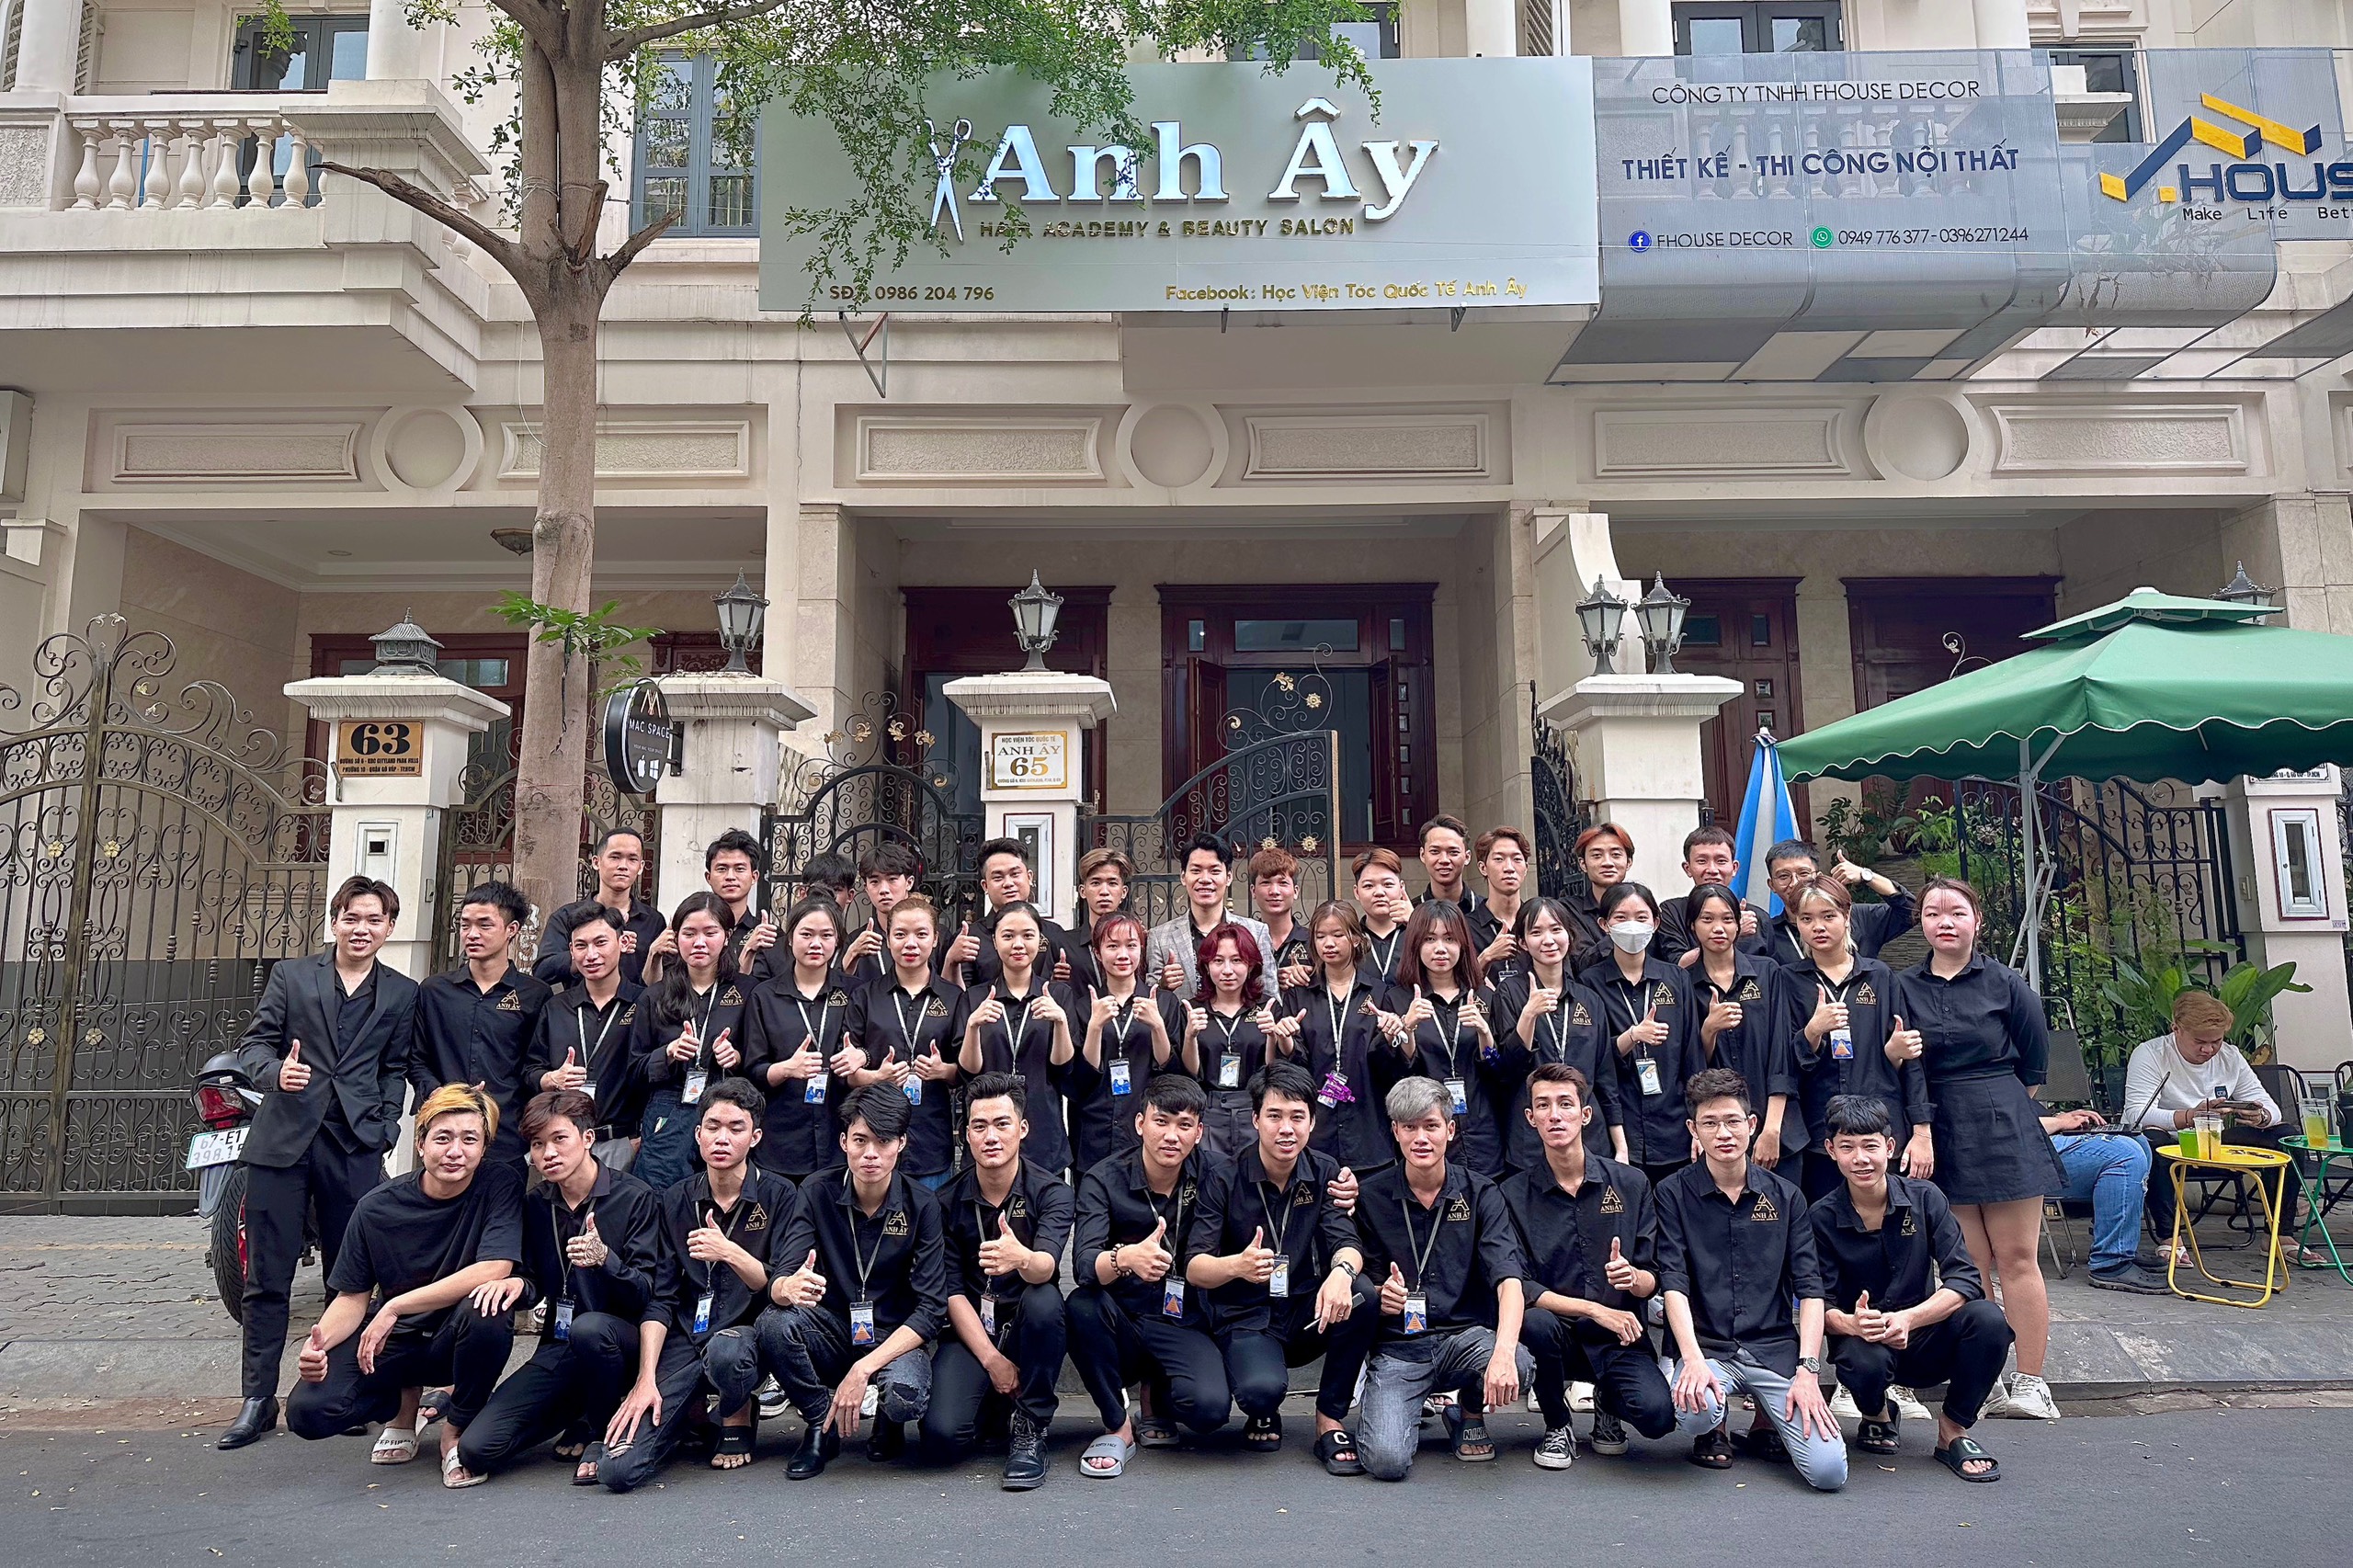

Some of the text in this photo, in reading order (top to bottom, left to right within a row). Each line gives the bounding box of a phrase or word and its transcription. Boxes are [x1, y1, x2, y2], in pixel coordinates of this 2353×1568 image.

[1653, 80, 1981, 104] CÔNG TY TNHH FHOUSE DECOR
[967, 97, 1440, 223] Anh Ây
[1621, 146, 1688, 180] THIẾT
[1698, 145, 1731, 179] KẾ
[1756, 154, 1794, 176] THI
[1802, 148, 1890, 175] CÔNG
[1897, 147, 1948, 178] NỘI
[1954, 138, 2019, 172] THẤT
[2183, 207, 2222, 222] Make
[2247, 207, 2288, 221] Life
[1043, 220, 1149, 238] ACADEMY
[1158, 220, 1171, 237] &
[1183, 219, 1268, 237] BEAUTY
[1280, 217, 1354, 236] SALON
[1837, 231, 1873, 245] 0949
[1876, 230, 1901, 244] 776
[1657, 231, 1793, 248] FHOUSE DECOR
[875, 285, 918, 301] 0986
[924, 285, 957, 301] 204
[963, 285, 995, 301] 796
[1165, 278, 1528, 302] Facebook: Học Viện Tóc Quốc Tế Anh Ây
[629, 718, 670, 739] MAC SPACE
[350, 723, 411, 756] 63
[997, 743, 1061, 756] ANH ÂY
[1010, 756, 1049, 777] 65
[199, 1129, 242, 1150] 67-E1
[1333, 1431, 1350, 1445] C
[1869, 1425, 1882, 1437] C
[1961, 1438, 1983, 1454] C
